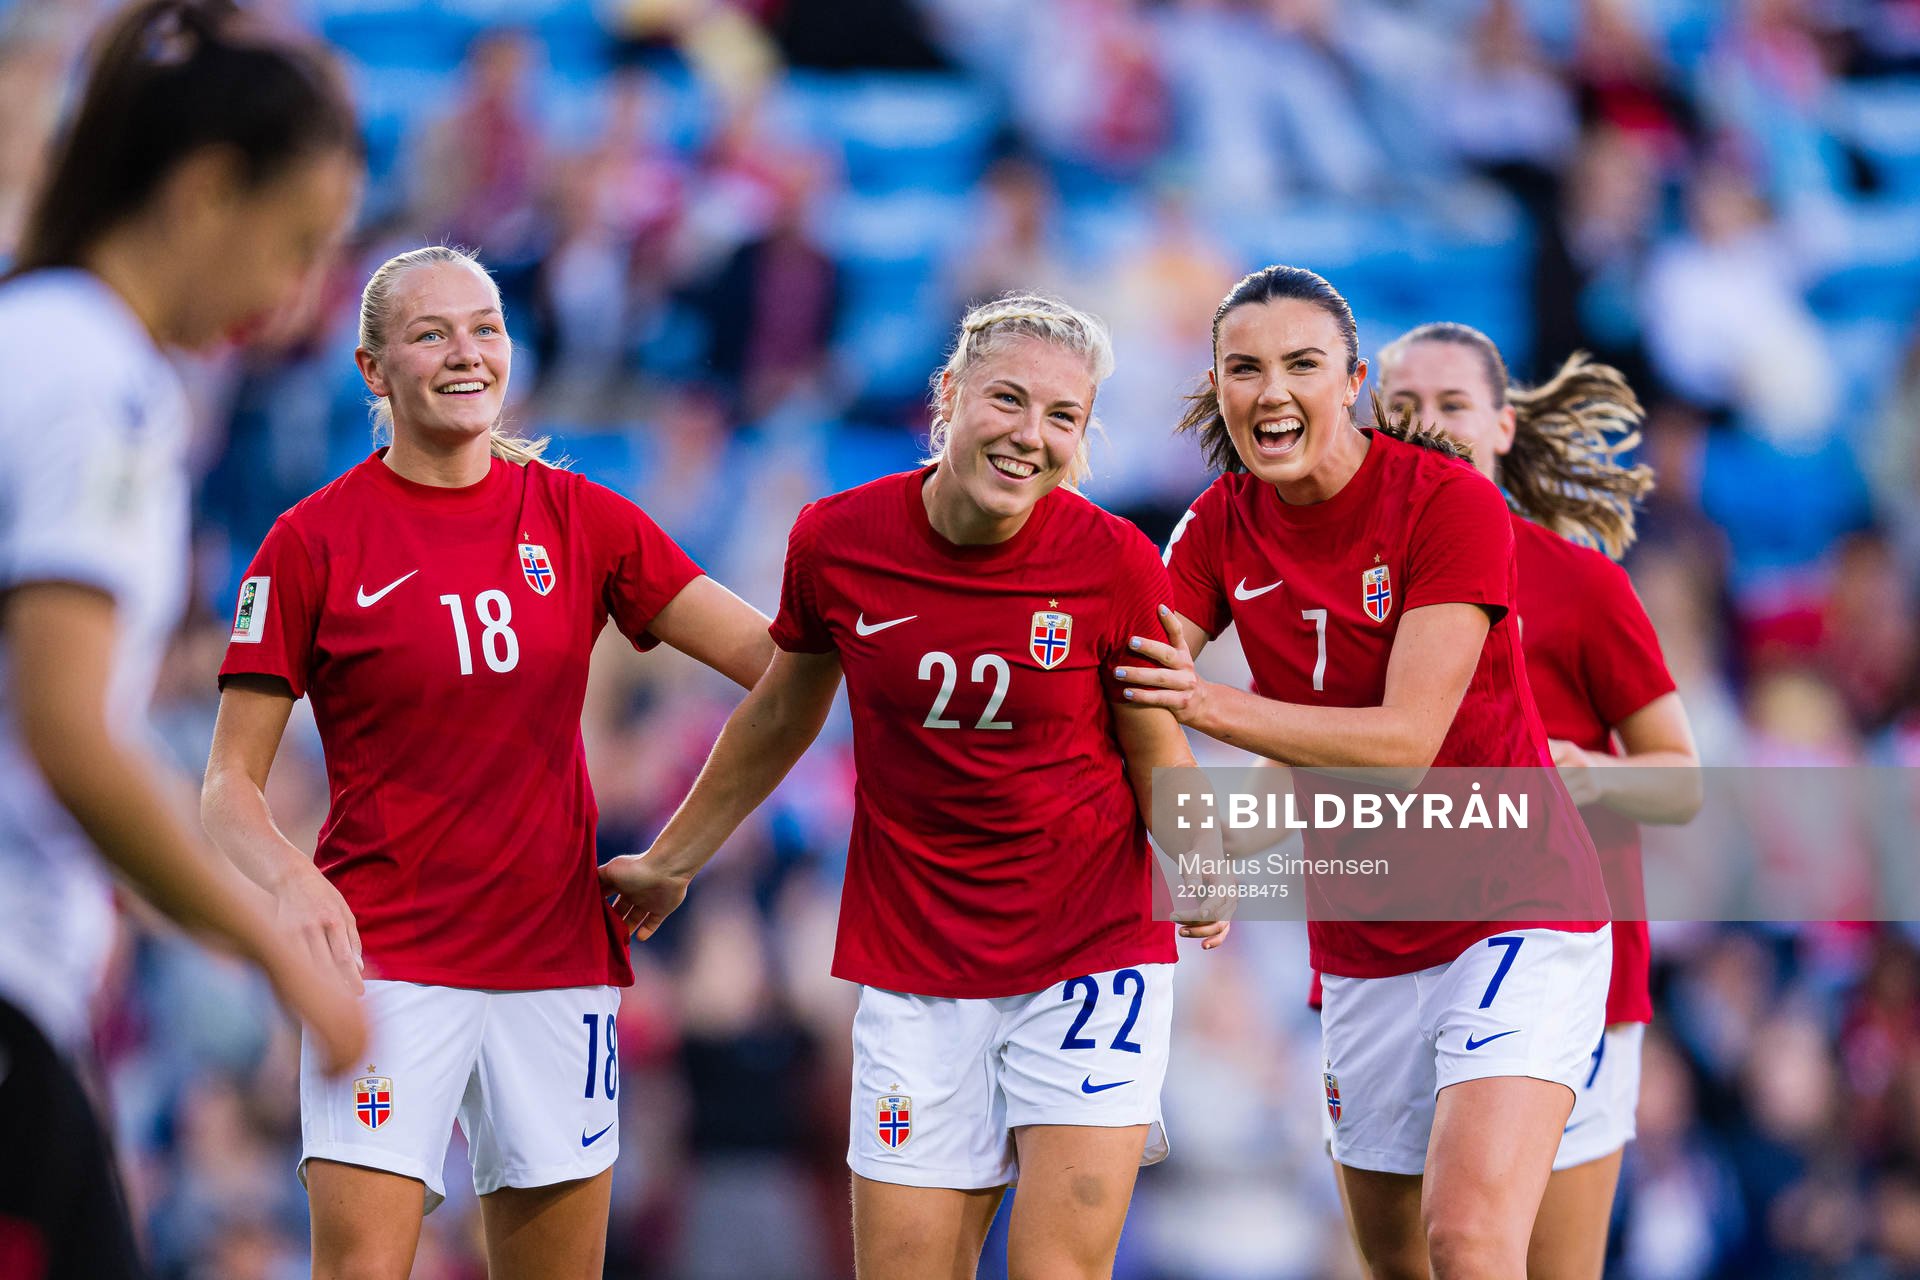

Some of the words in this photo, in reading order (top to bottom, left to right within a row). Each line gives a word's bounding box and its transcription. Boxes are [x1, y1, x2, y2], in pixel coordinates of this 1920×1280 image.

[440, 589, 520, 675] 18
[1301, 608, 1328, 691] 7
[917, 651, 1013, 730] 22
[1060, 968, 1146, 1054] 22
[1478, 936, 1525, 1010] 7
[583, 1013, 617, 1101] 18
